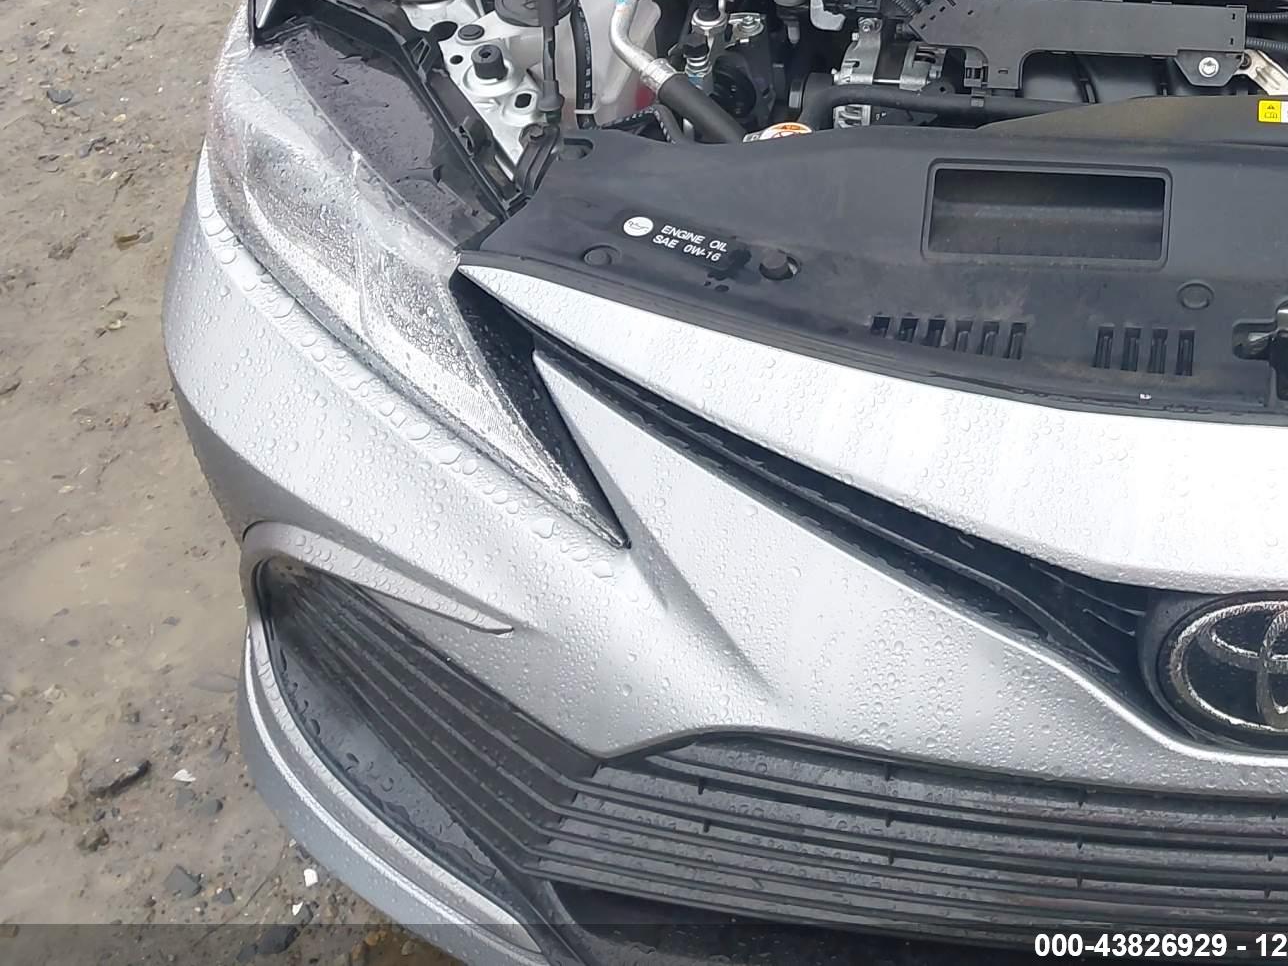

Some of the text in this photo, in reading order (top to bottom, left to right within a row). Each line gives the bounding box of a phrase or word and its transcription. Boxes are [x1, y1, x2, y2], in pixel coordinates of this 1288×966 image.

[652, 235, 721, 261] SAE 0W-16
[661, 225, 728, 252] ENGINE OIL
